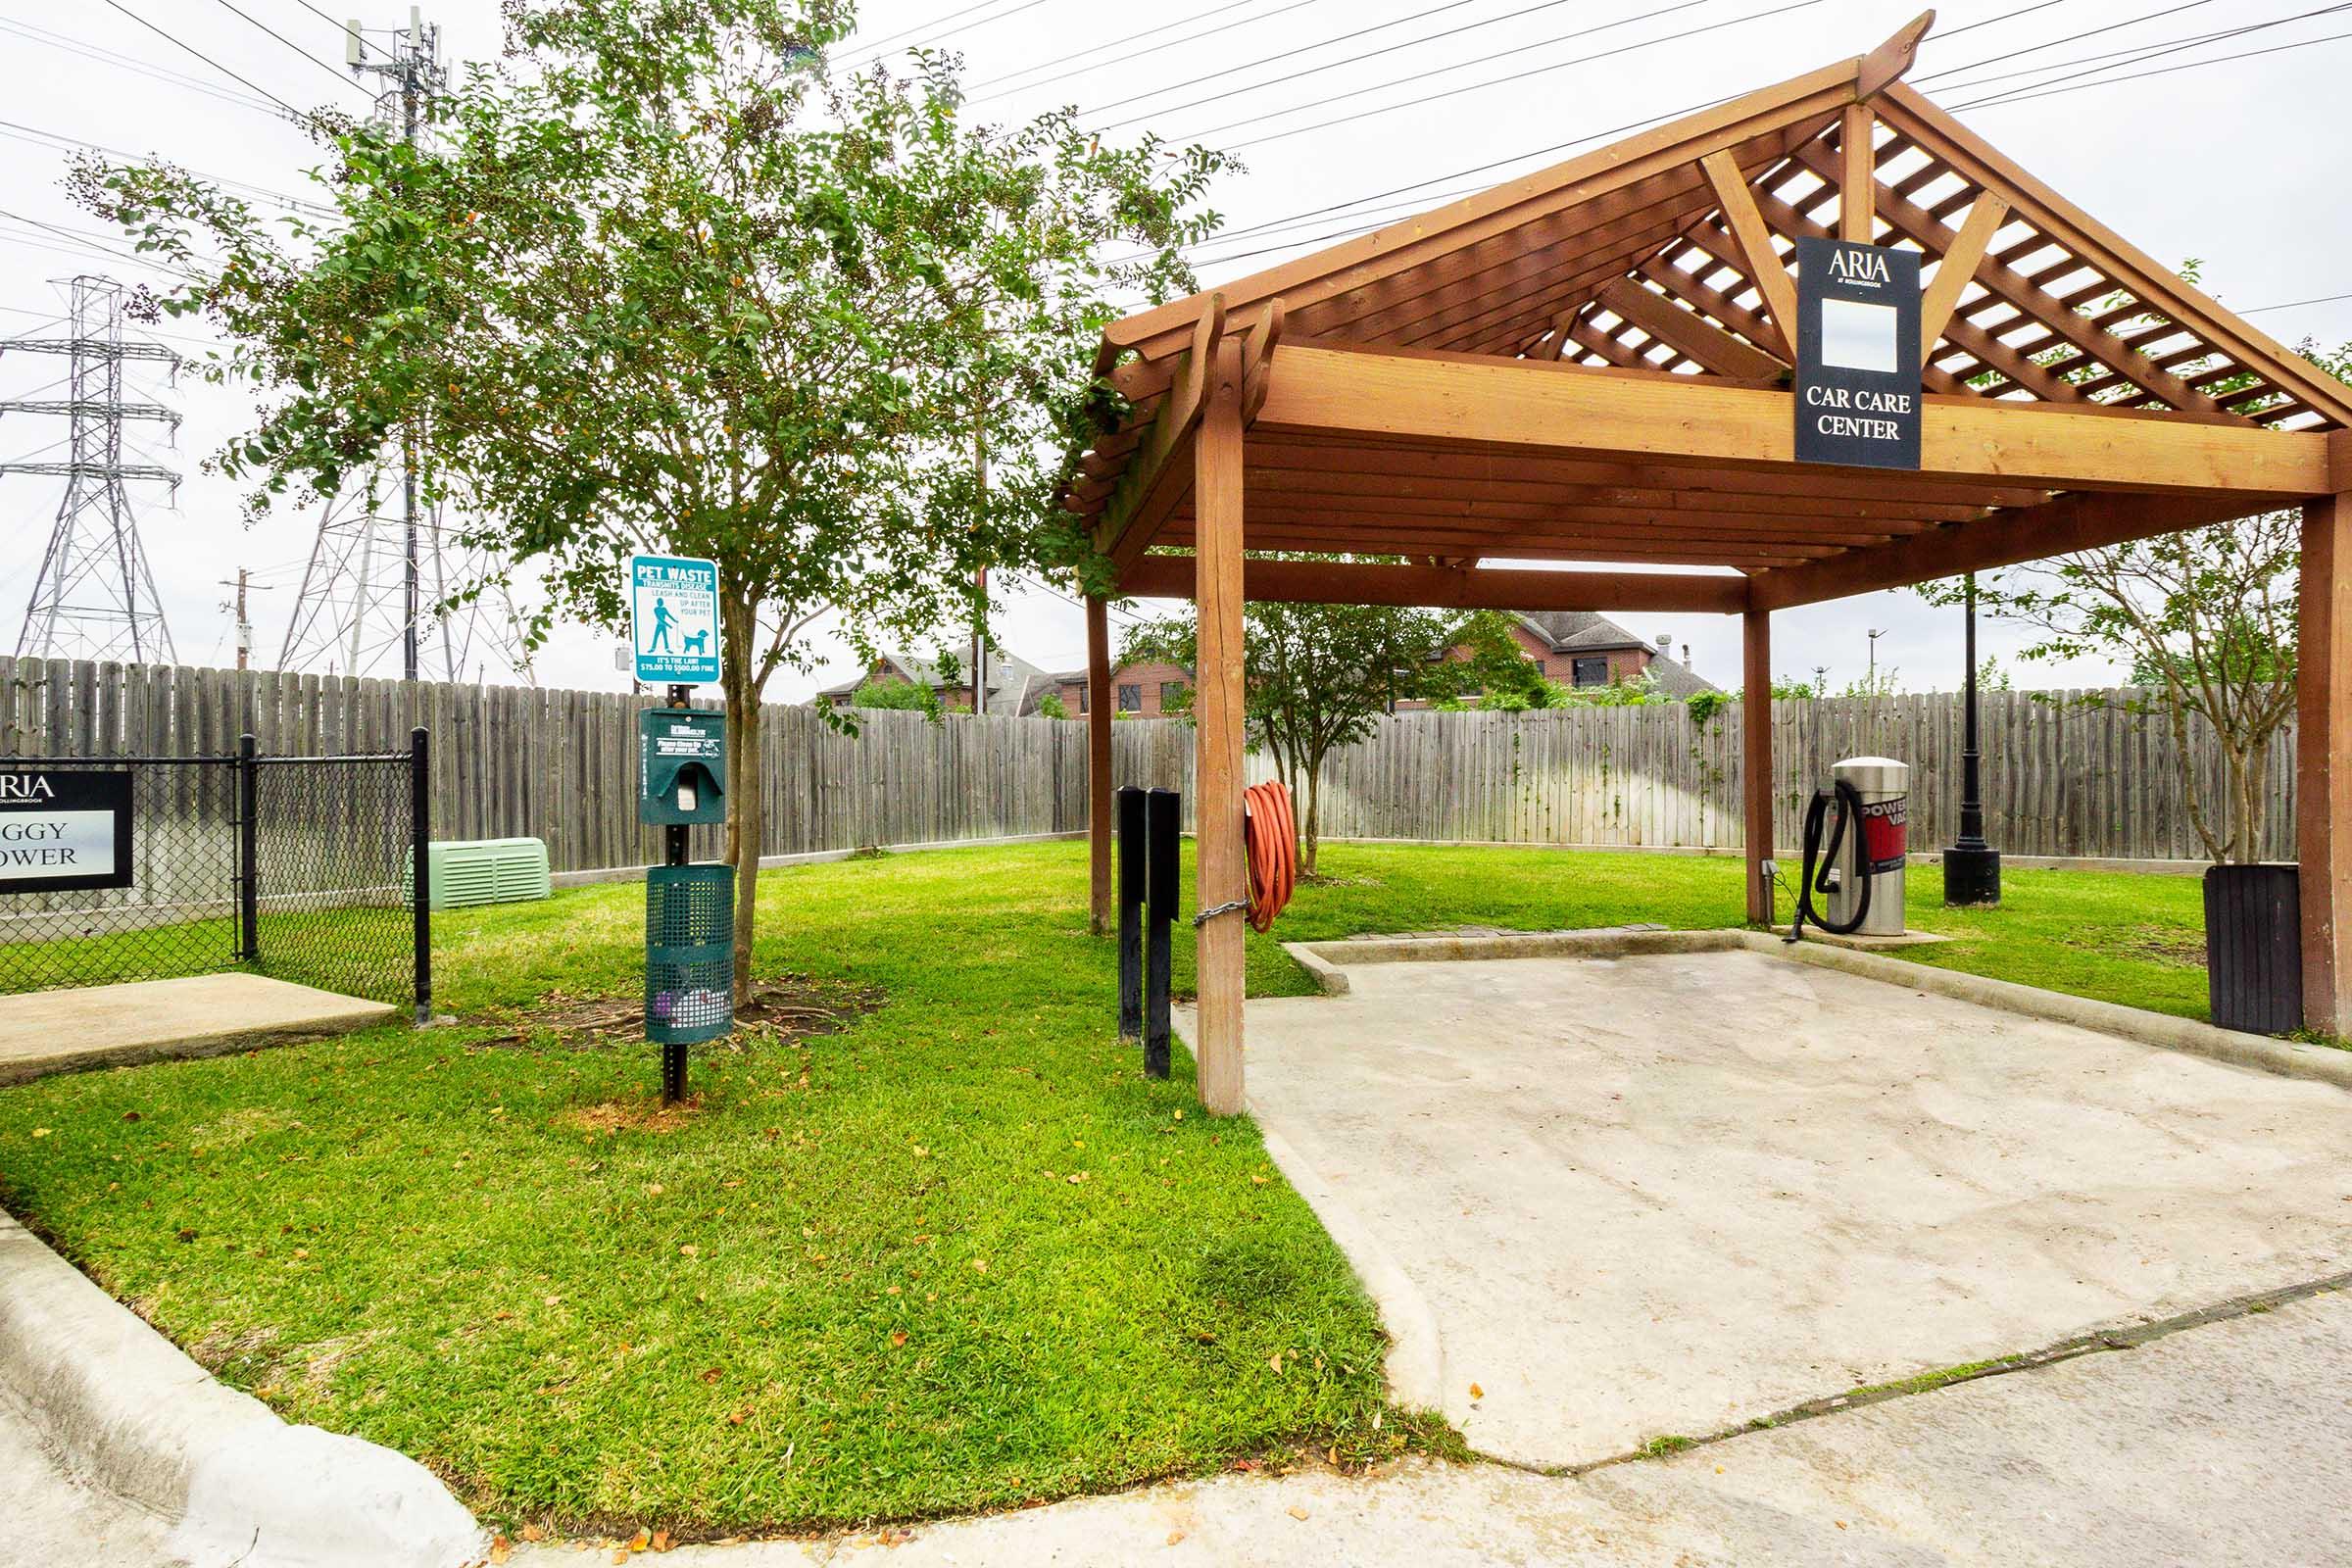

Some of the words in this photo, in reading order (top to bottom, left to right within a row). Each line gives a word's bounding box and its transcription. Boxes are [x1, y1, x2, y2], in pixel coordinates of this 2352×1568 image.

[1828, 249, 1890, 282] ARIA
[1806, 385, 1851, 409] CAR
[1854, 391, 1911, 414] CARE
[1817, 415, 1900, 440] CENTER
[637, 565, 662, 579] PET
[667, 567, 711, 585] WASTE
